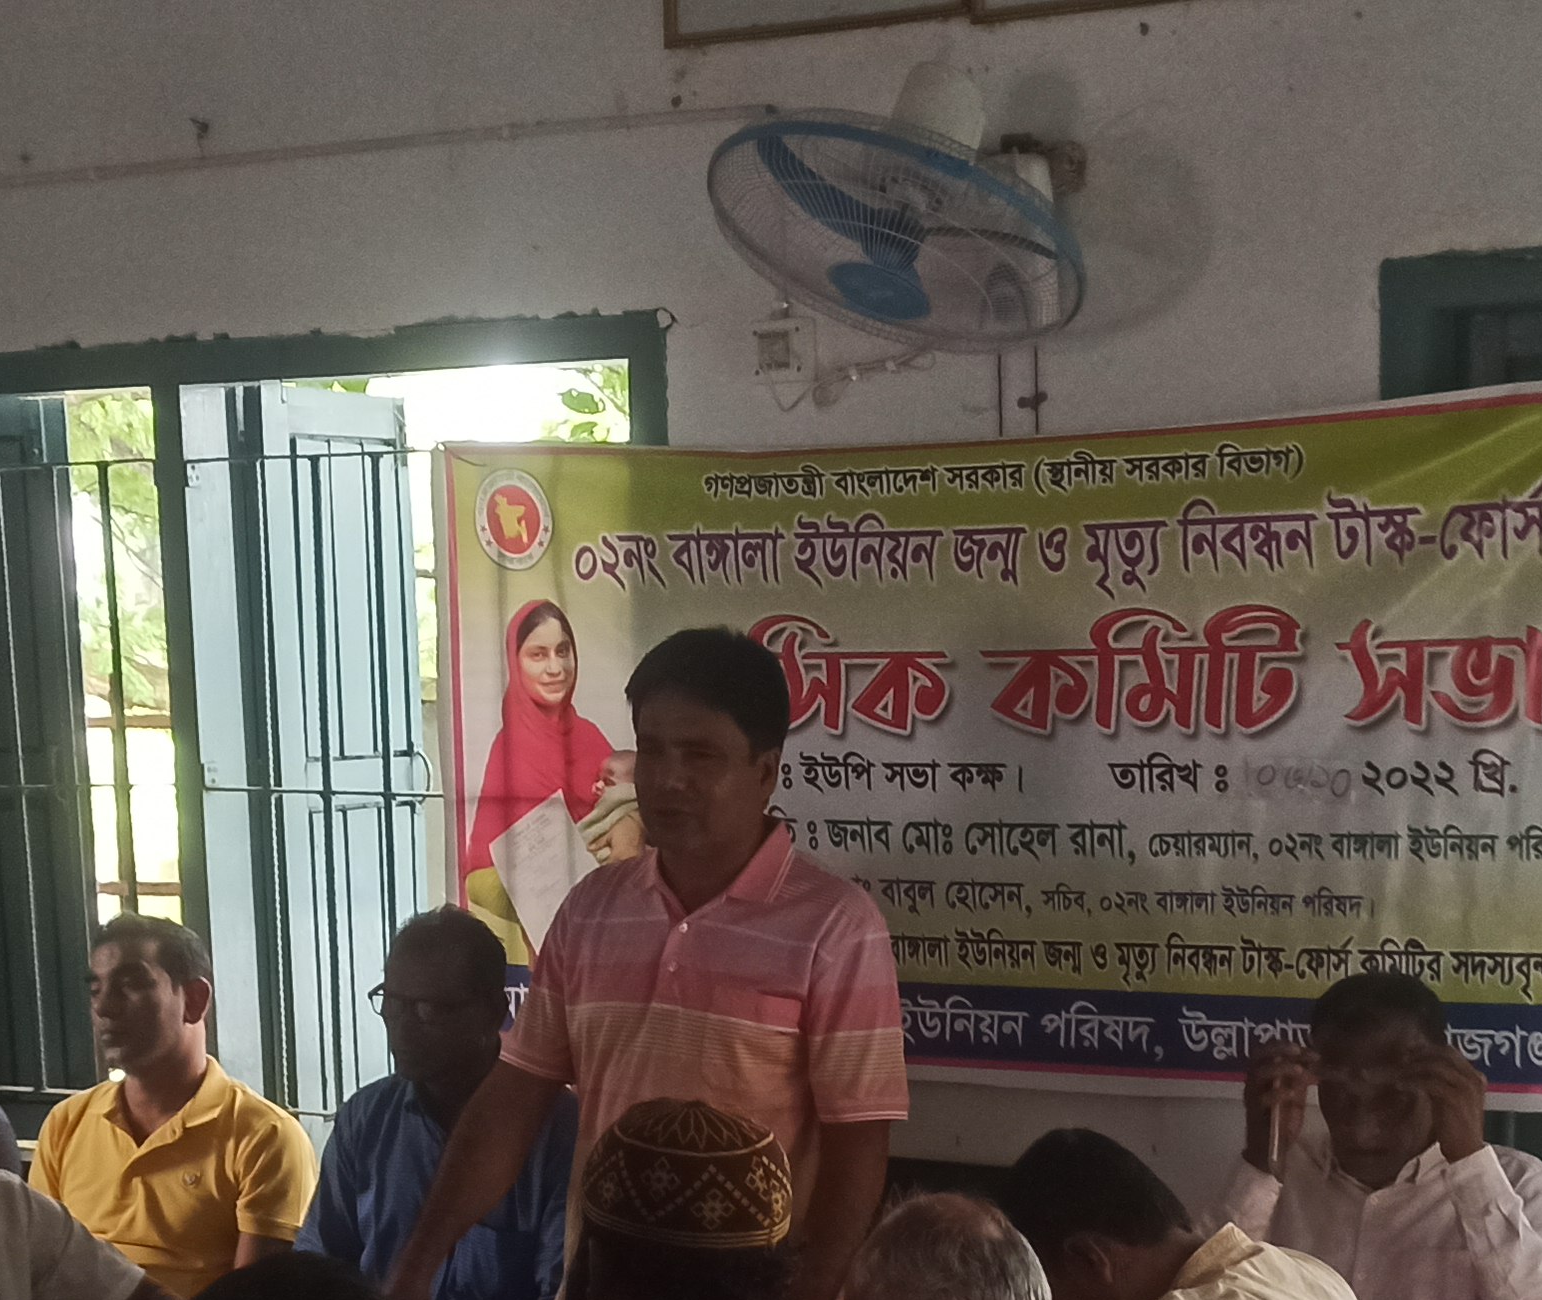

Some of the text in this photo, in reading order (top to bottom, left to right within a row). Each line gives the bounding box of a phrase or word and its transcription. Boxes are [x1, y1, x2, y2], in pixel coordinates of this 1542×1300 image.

[830, 466, 938, 496] বাংলাদেশ
[944, 461, 1025, 491] সরকার
[1033, 450, 1117, 495] (স্থানীয়
[1123, 452, 1210, 482] সরকার
[1216, 443, 1305, 480] বিভাগ)
[575, 533, 666, 591] ০২নং
[667, 526, 785, 586] বাঙ্গালা
[794, 513, 943, 590] ইউনিয়ন
[953, 526, 1027, 587] জন্ম
[1039, 526, 1067, 574] ও
[1083, 519, 1168, 600] মৃত্যু
[1178, 498, 1318, 575] নিবন্ধন
[978, 605, 1302, 732] কমিটি
[799, 752, 875, 793] ইউপি
[882, 758, 940, 793] সভা
[948, 761, 1007, 793] কক্ষ
[1107, 752, 1203, 793] তারিখ
[1361, 760, 1459, 797] ২০২২
[824, 816, 892, 852] জনাব
[964, 820, 1060, 861] সোহেল
[1067, 818, 1136, 866] রানা,
[1268, 832, 1325, 861] ০২নং
[1330, 830, 1402, 861] বাঙ্গালা
[1406, 824, 1499, 864] ইউনিয়ন
[877, 875, 936, 916] বাবুল
[945, 877, 1032, 918] হোসেন,
[1100, 891, 1149, 915] ০২নং
[1222, 885, 1296, 917] ইউনিয়ন
[1302, 887, 1363, 917] পরিষদ
[954, 926, 1037, 972] ইউনিয়ন
[1042, 940, 1083, 976] জন্ম
[1090, 942, 1108, 971] ও
[1114, 942, 1160, 987] মৃত্যু
[1164, 931, 1236, 978] নিবন্ধন
[1358, 937, 1446, 983] কমিটির
[1040, 1000, 1164, 1062] পরিষদ,
